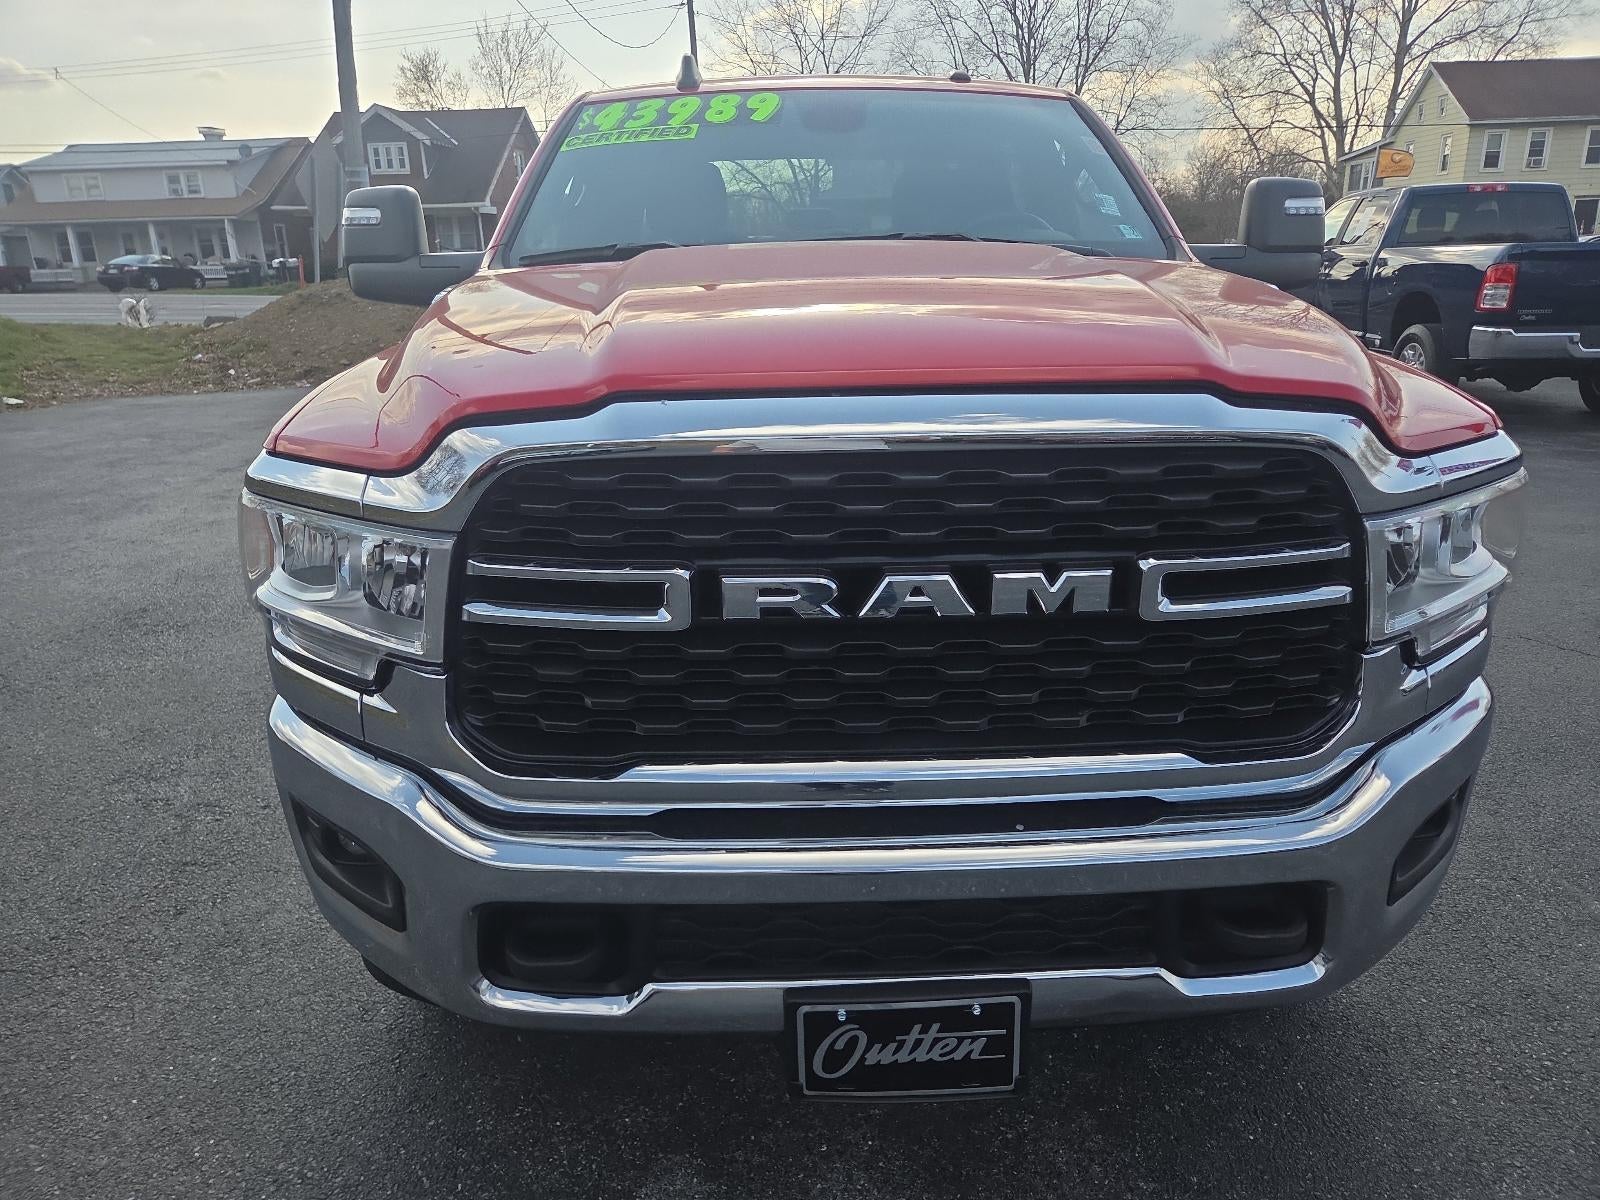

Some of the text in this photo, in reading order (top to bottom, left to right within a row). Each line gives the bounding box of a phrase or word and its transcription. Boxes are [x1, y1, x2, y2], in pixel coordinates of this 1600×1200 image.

[564, 125, 694, 149] CERTIFIED
[721, 569, 1113, 620] RAM
[812, 1022, 1007, 1079] Outten
